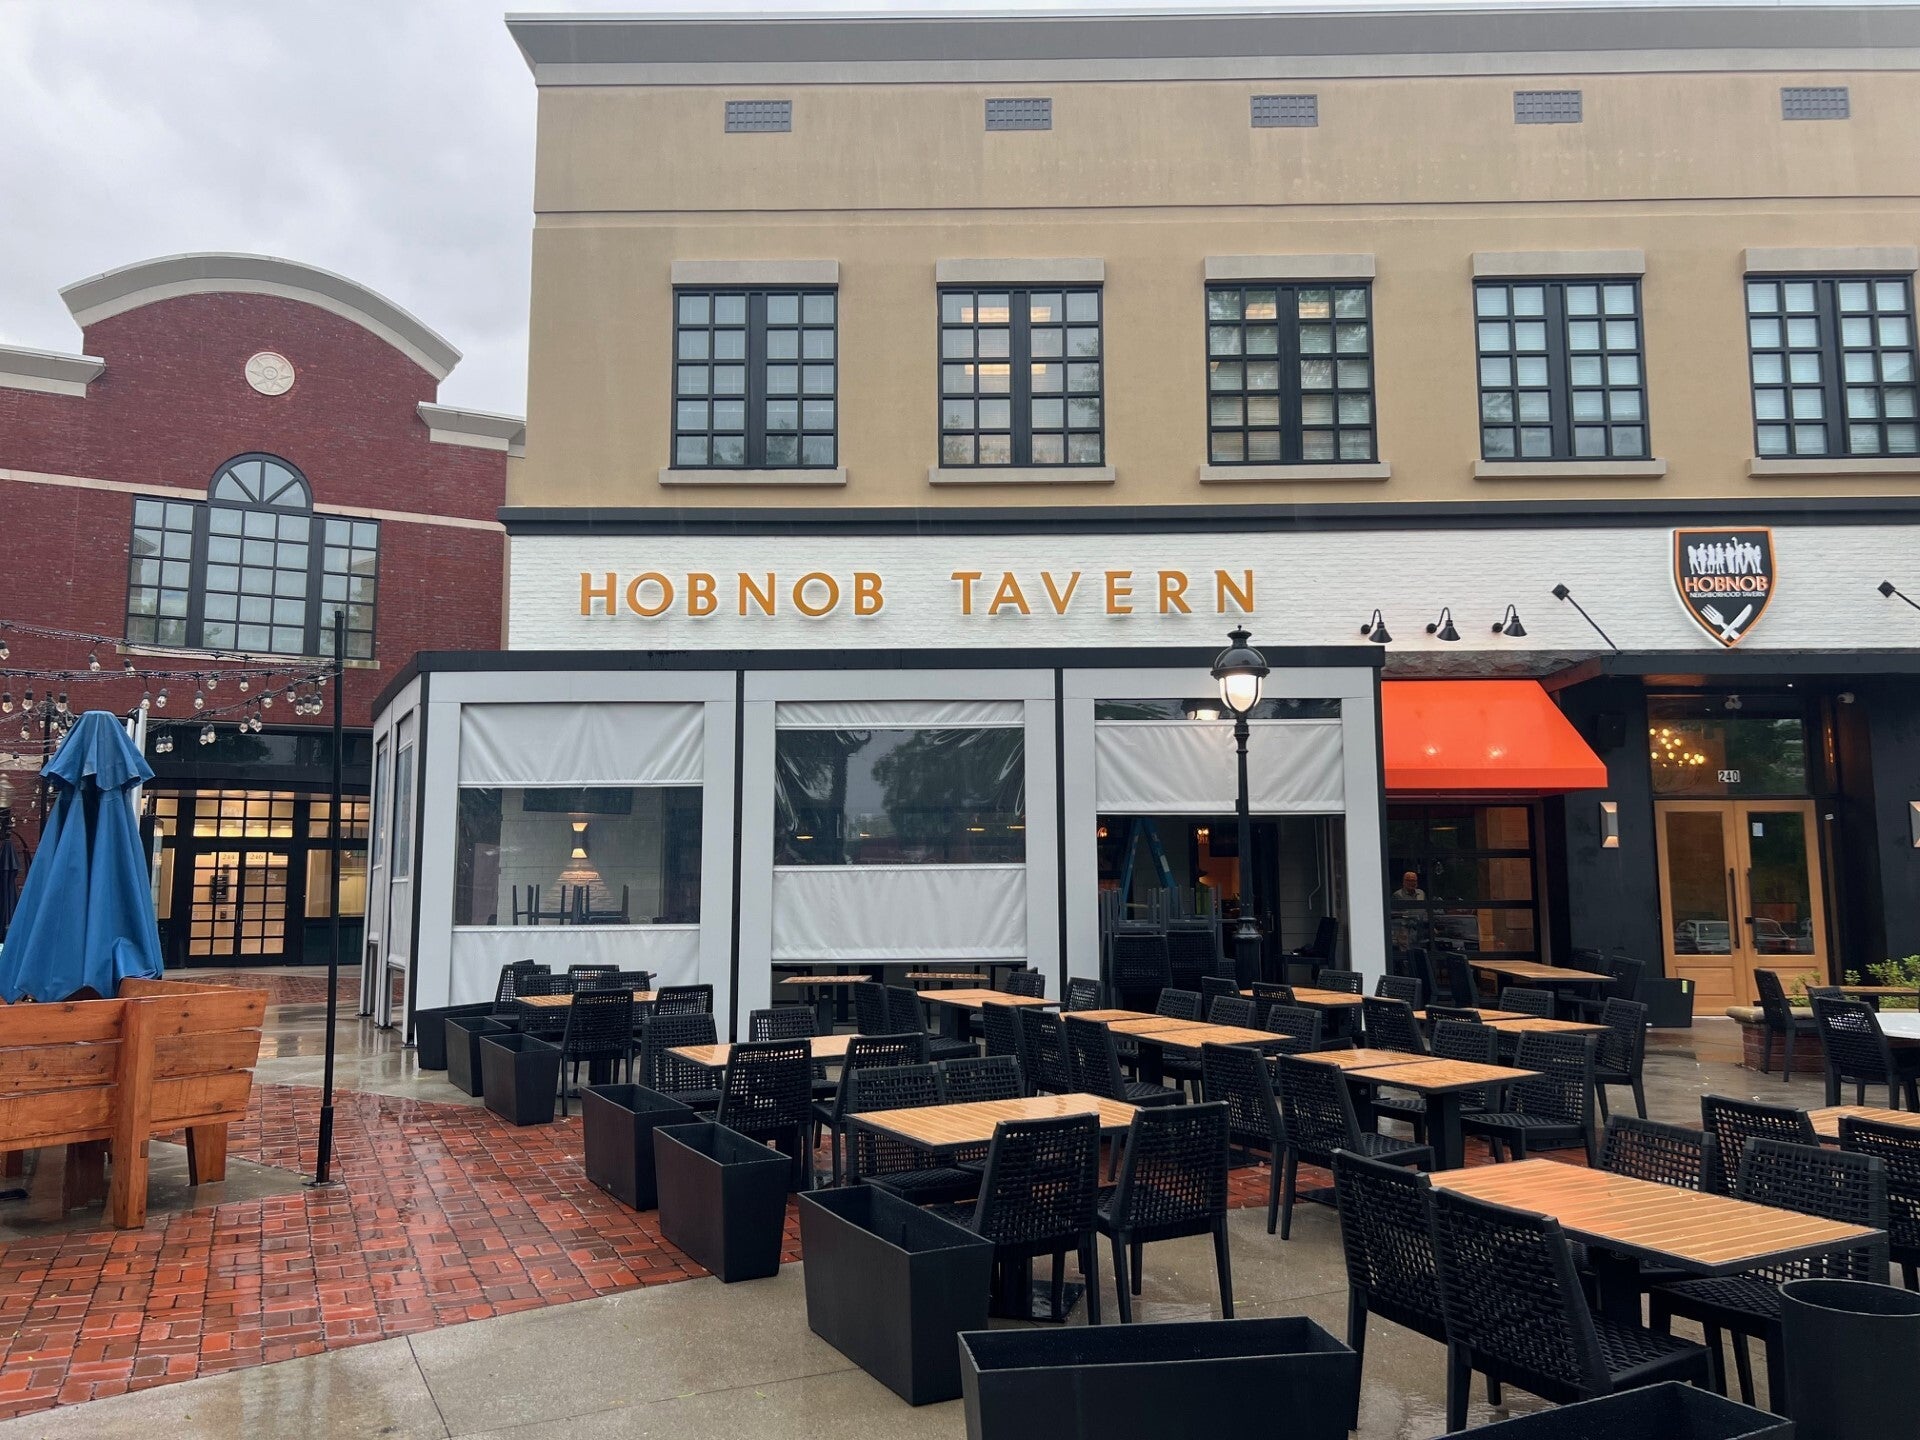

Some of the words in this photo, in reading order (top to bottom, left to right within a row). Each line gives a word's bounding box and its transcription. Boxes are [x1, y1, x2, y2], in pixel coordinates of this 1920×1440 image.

[1684, 575, 1769, 592] HOBNOB
[580, 572, 884, 617] HOBNOB
[951, 569, 1254, 615] TAVERN
[1719, 770, 1739, 782] 240
